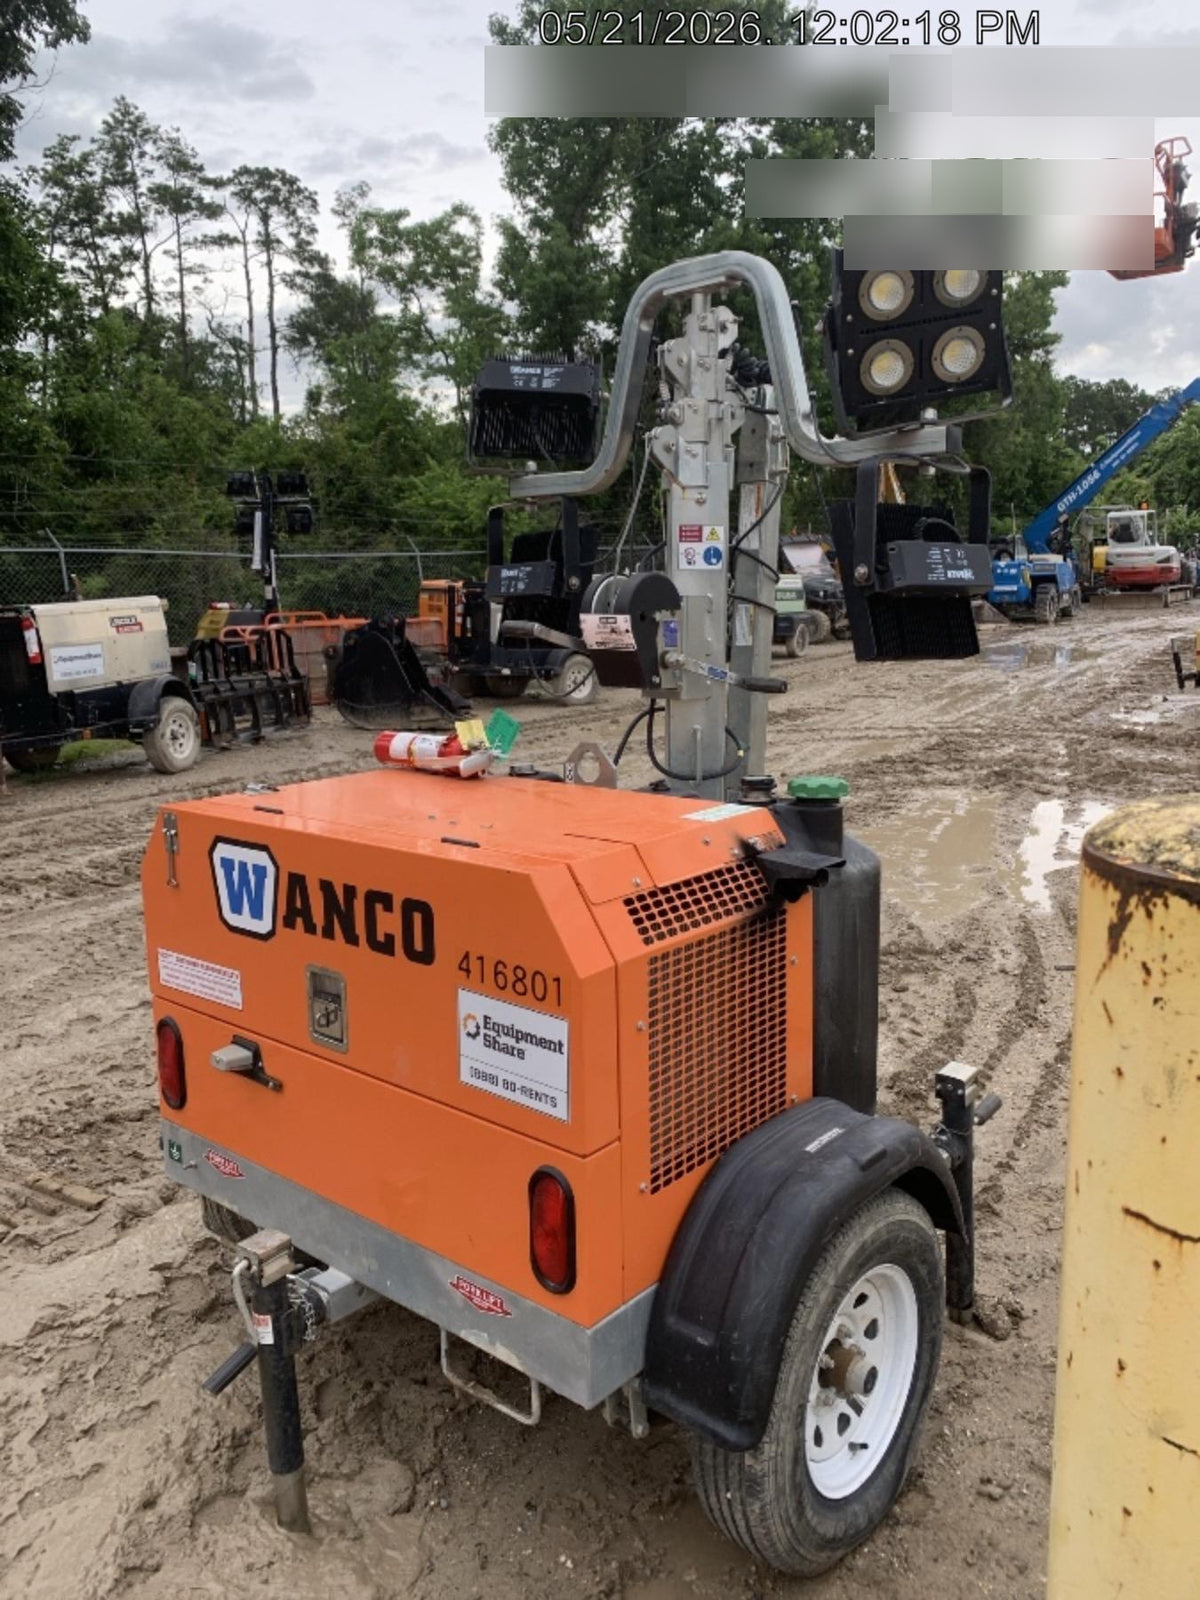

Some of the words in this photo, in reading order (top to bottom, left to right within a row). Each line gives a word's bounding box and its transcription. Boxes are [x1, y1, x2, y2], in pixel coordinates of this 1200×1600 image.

[219, 855, 436, 967] WANCO
[458, 950, 562, 1007] 416801
[482, 1014, 565, 1056] Equipment
[482, 1033, 526, 1061] Share
